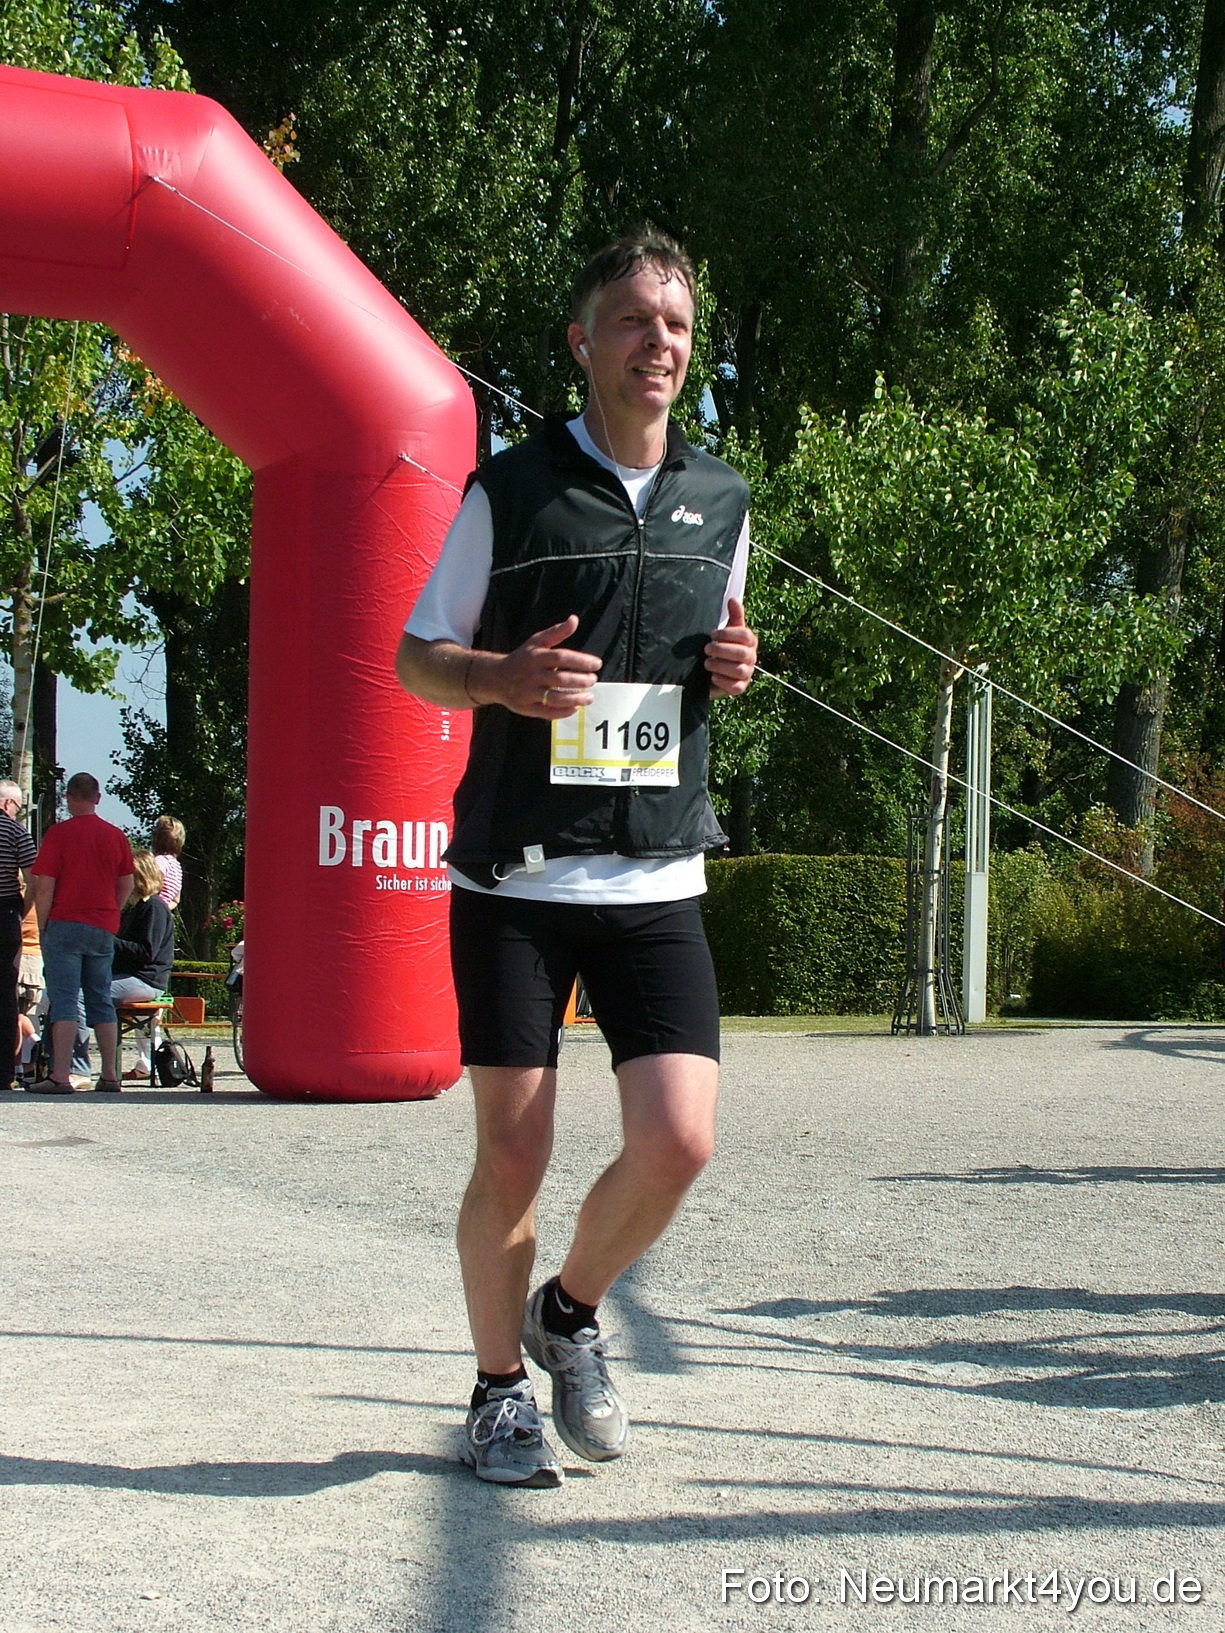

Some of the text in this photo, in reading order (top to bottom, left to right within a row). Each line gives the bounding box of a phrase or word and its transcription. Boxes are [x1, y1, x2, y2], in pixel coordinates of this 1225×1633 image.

[595, 719, 670, 752] 1169
[553, 766, 605, 778] BOCK
[318, 805, 448, 869] Braun
[376, 873, 452, 891] Sicher ist siche
